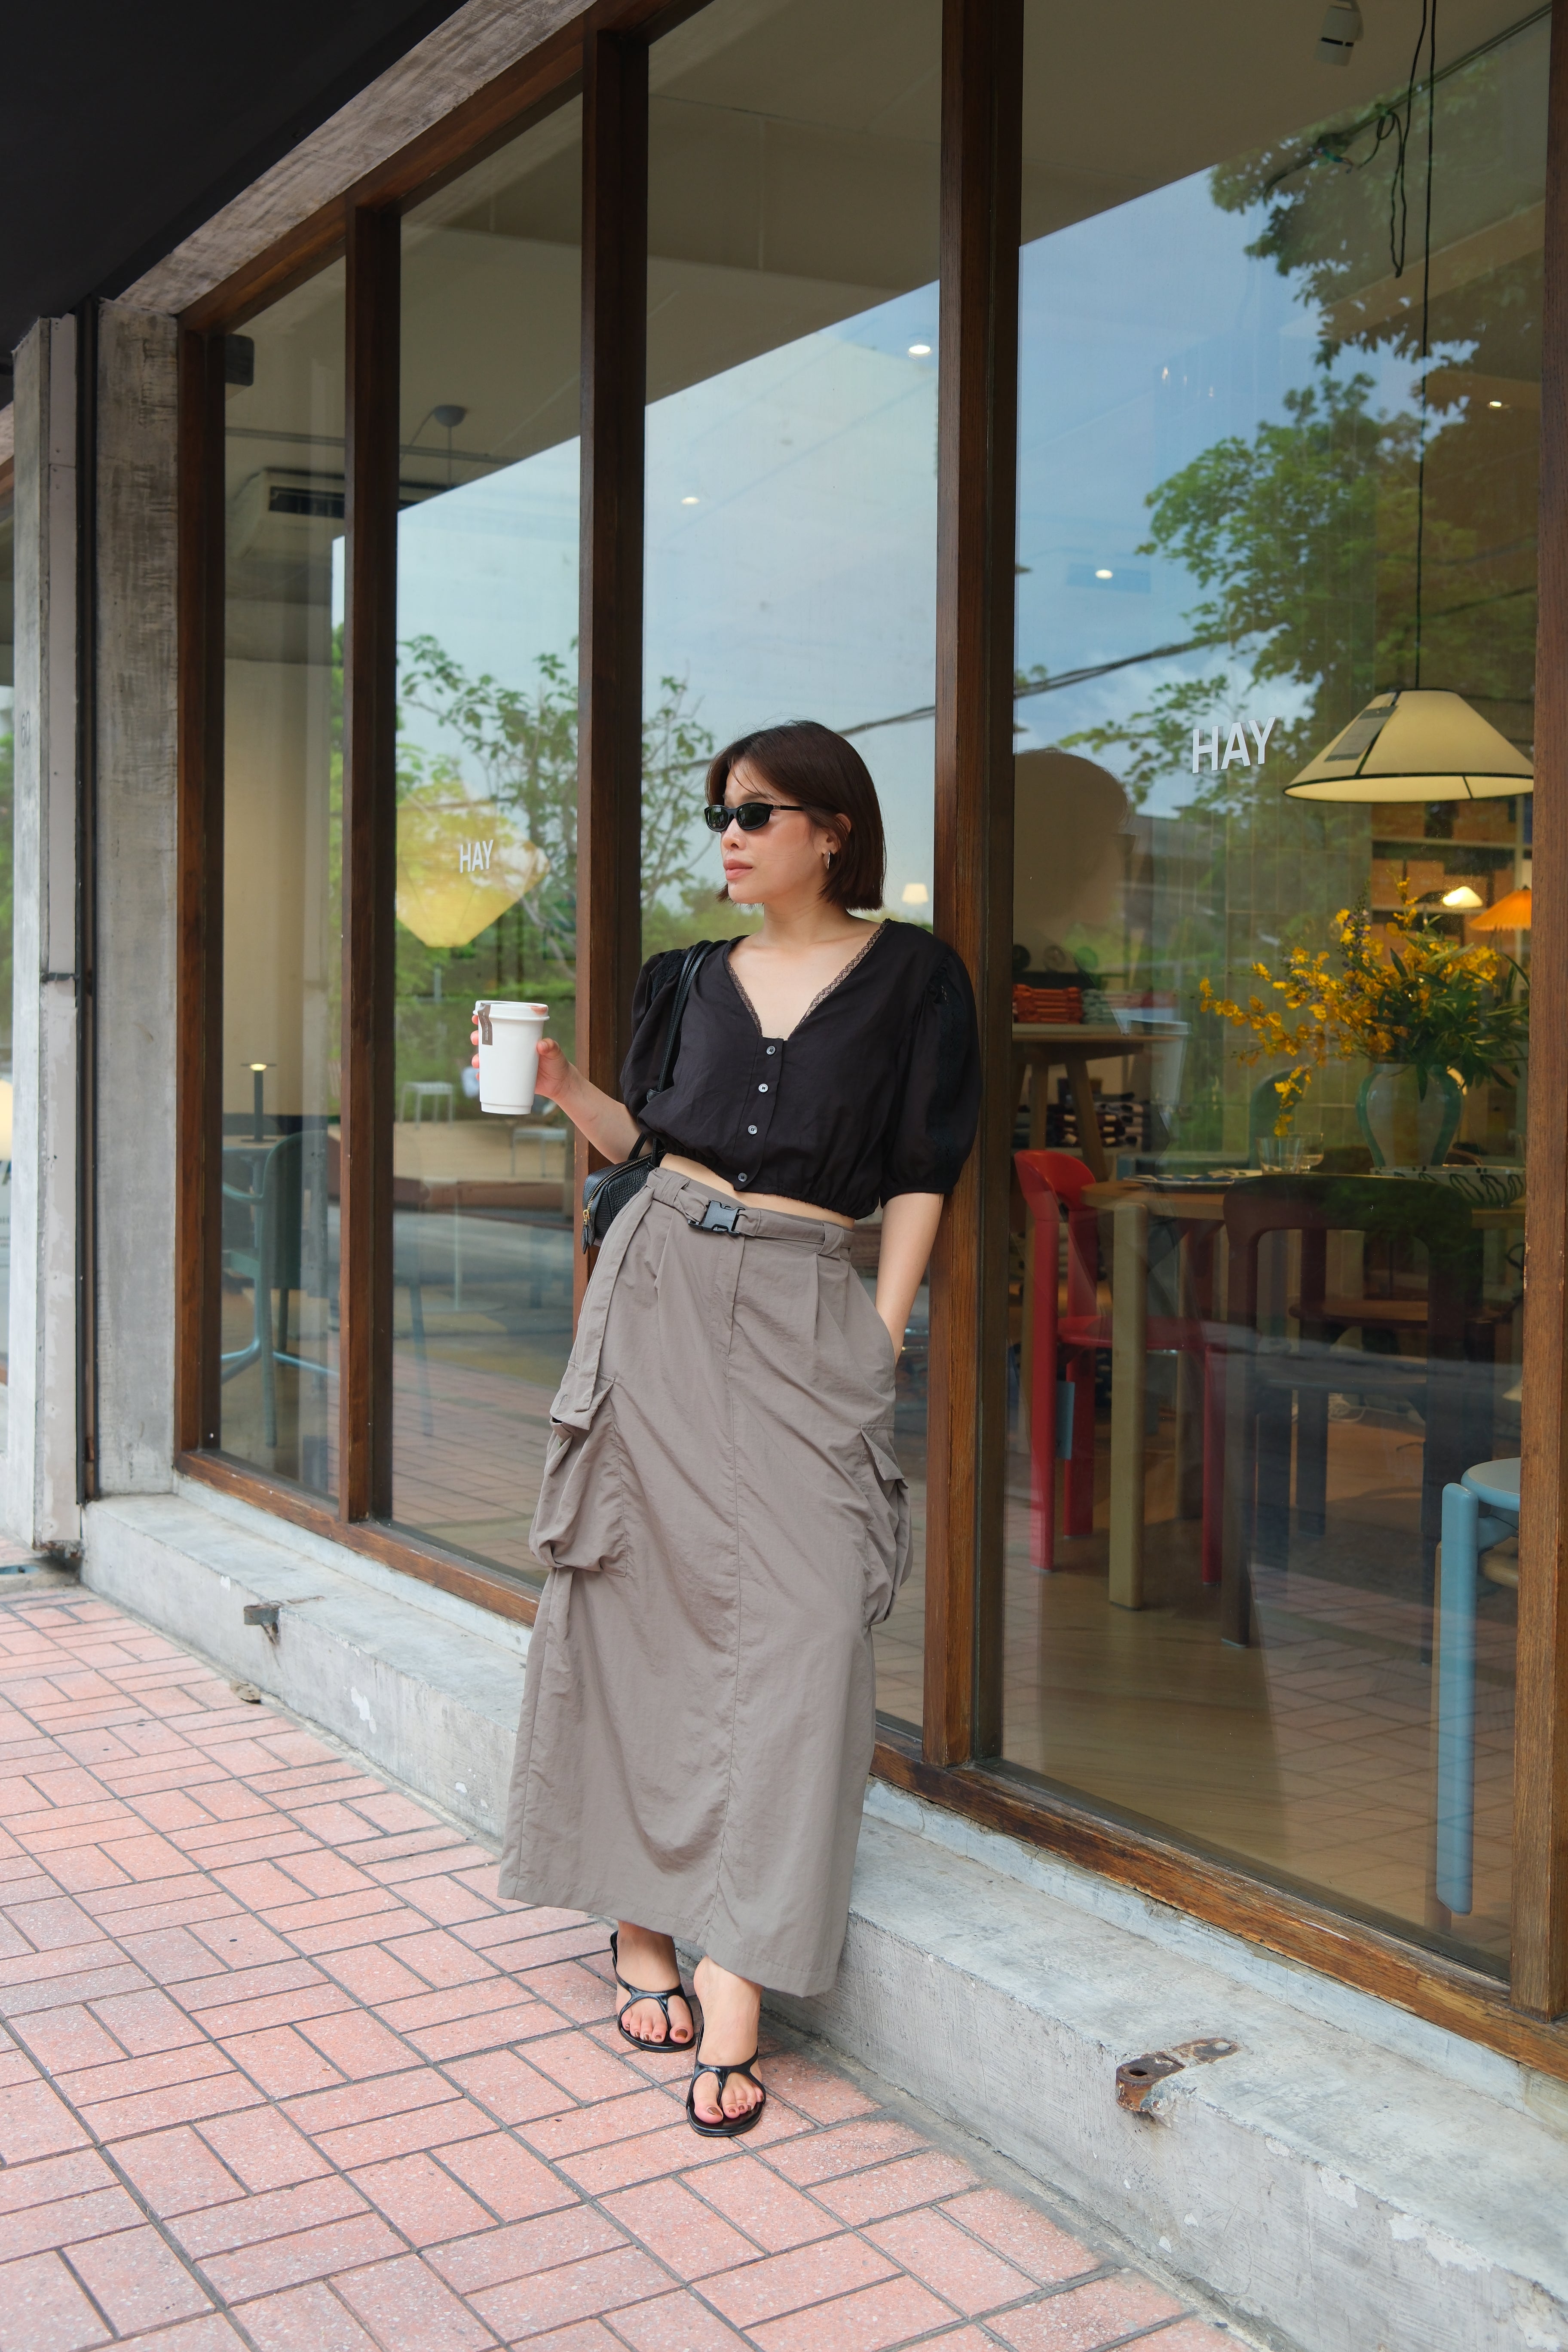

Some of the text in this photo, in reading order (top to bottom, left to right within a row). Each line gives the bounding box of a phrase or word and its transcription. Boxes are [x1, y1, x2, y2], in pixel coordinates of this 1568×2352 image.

[21, 710, 31, 747] 60
[1192, 716, 1276, 773] HAY
[460, 839, 493, 873] HAY
